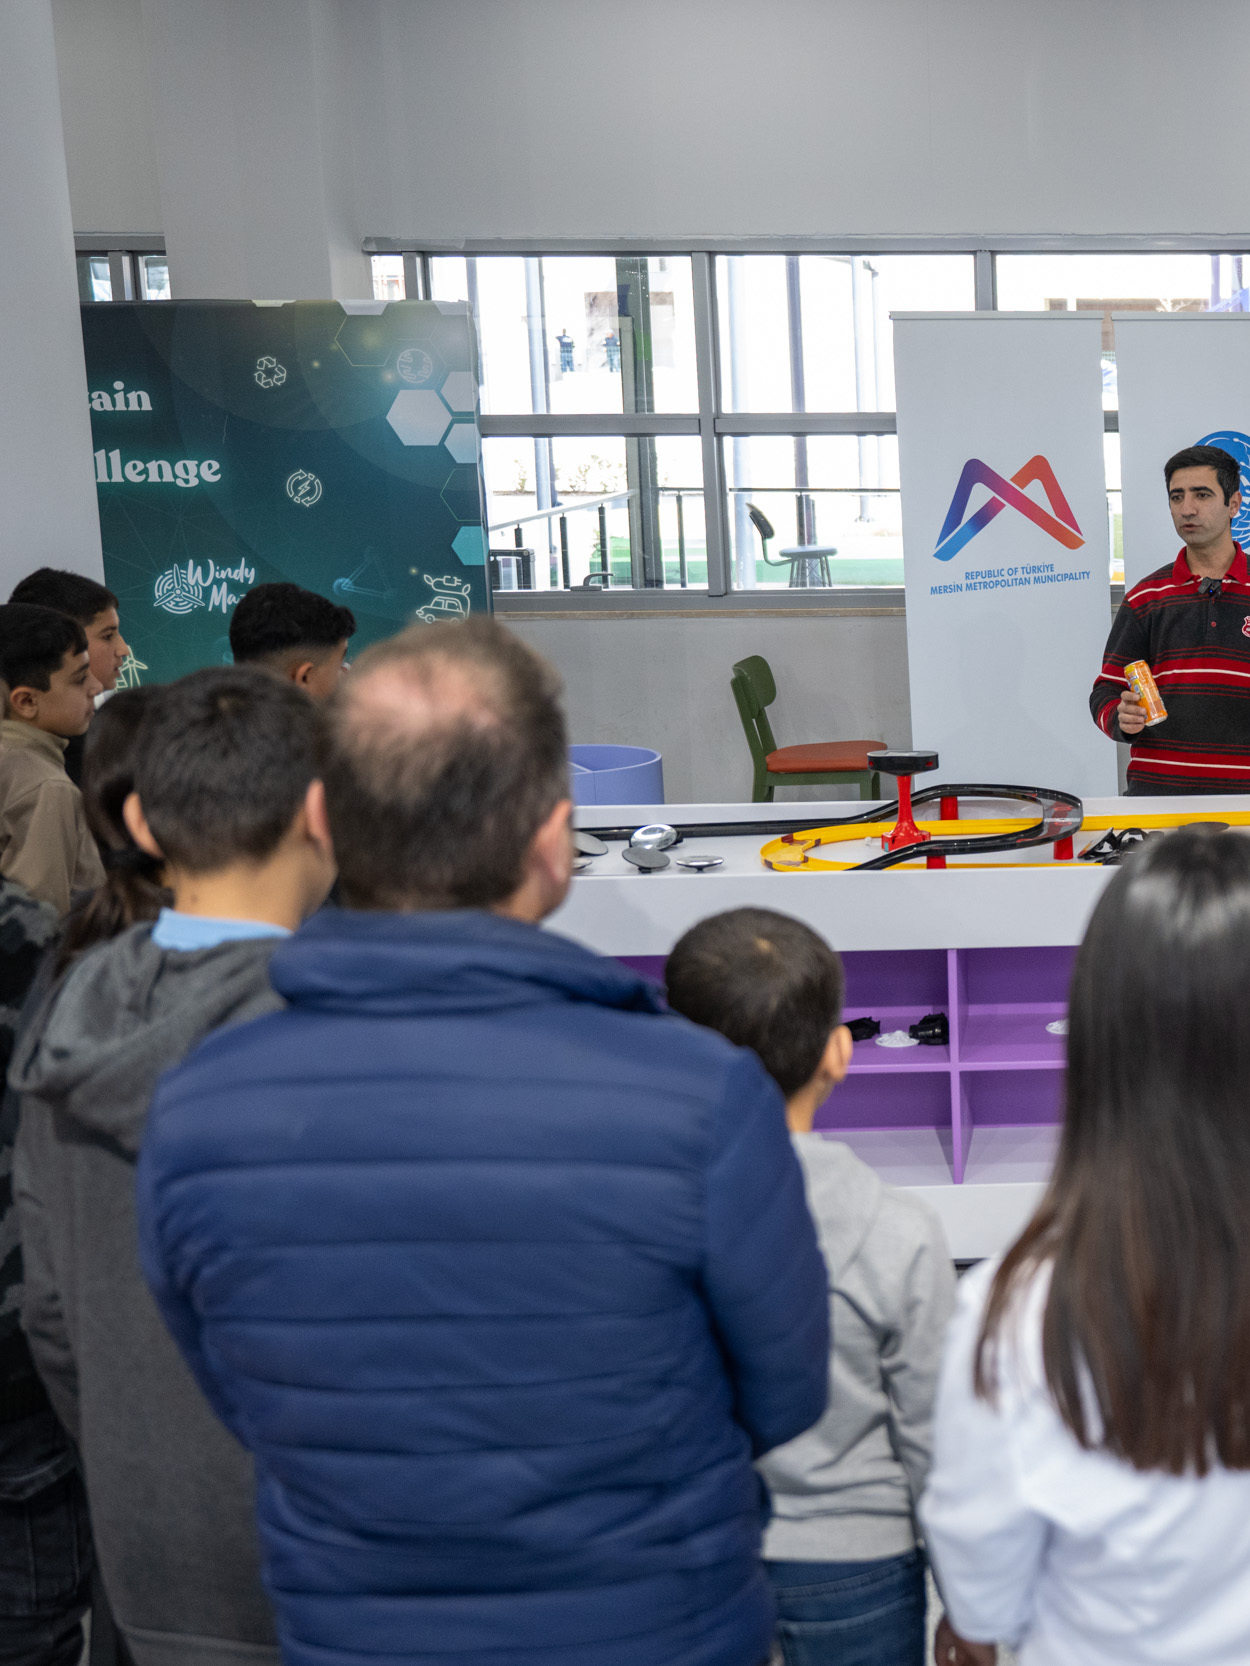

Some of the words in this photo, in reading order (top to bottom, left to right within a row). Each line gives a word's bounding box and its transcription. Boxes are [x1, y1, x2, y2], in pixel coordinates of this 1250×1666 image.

[88, 381, 153, 411] ain
[94, 449, 222, 488] llenge
[187, 557, 255, 586] Windy
[930, 581, 963, 596] MERSİN
[965, 576, 1031, 592] METROPOLITAN
[1033, 570, 1091, 585] MUNICIPALITY
[965, 568, 1005, 581] REPUBLIC
[1006, 567, 1018, 577] OF
[1021, 562, 1054, 575] TÜRKİYE
[208, 581, 247, 614] Ma
